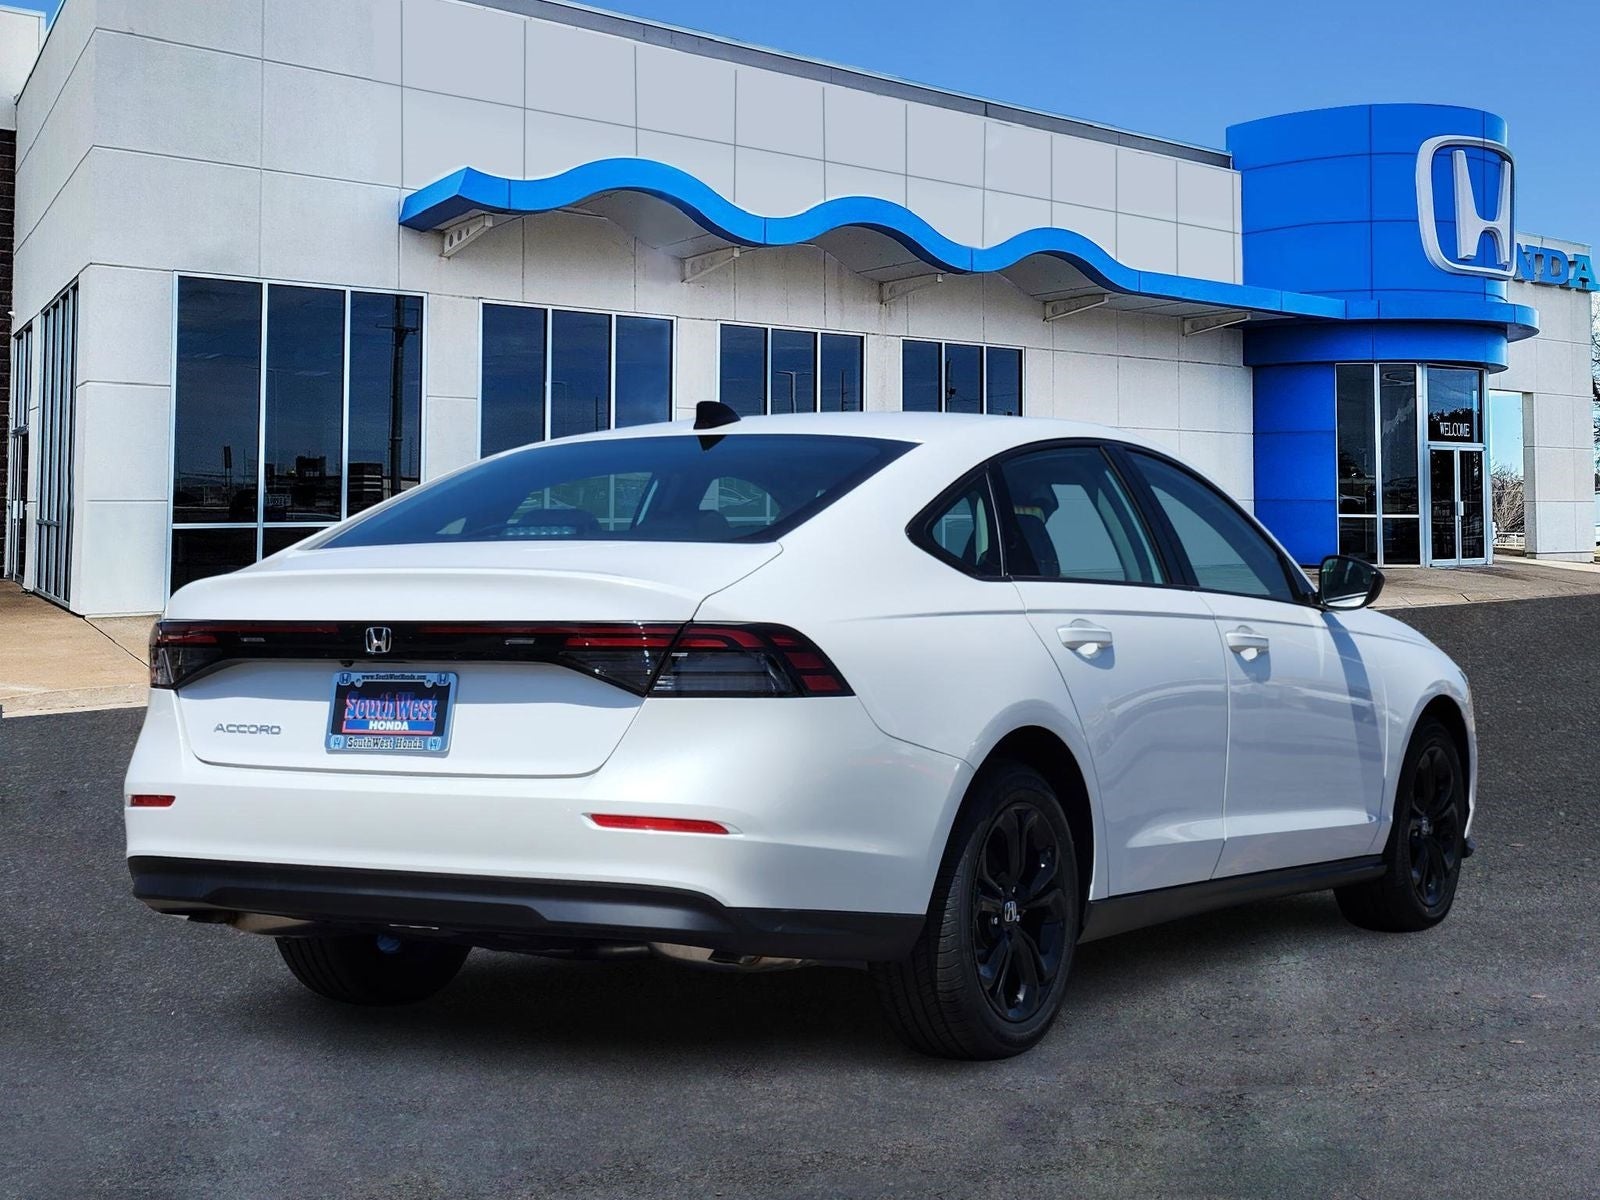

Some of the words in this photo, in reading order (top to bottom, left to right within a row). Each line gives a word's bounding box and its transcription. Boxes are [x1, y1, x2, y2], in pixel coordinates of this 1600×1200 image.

[1440, 422, 1470, 437] WELCOME
[214, 723, 282, 735] ACCORD
[369, 720, 409, 730] HONDA
[347, 737, 392, 749] SouthWest
[395, 738, 424, 749] Honda
